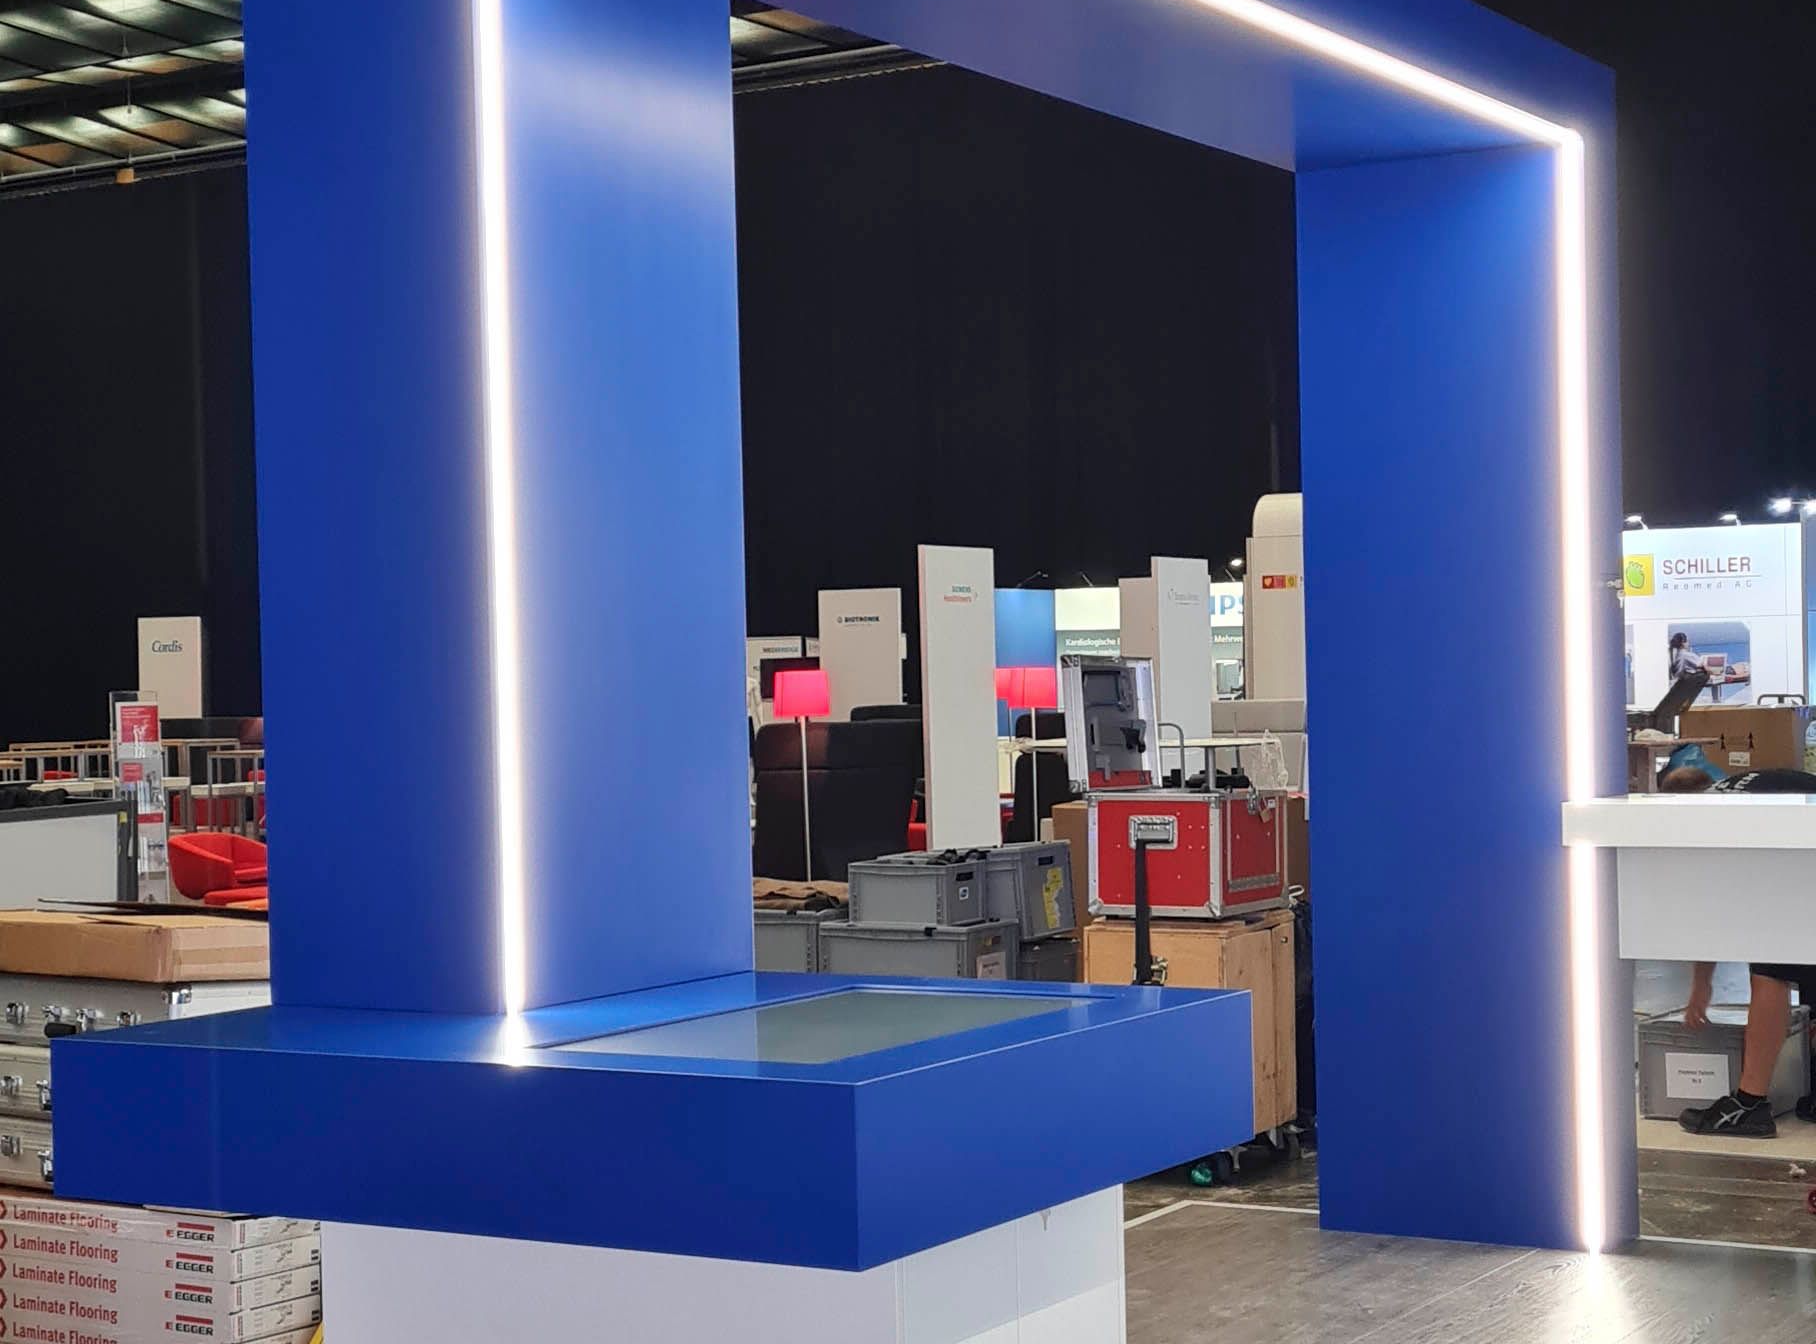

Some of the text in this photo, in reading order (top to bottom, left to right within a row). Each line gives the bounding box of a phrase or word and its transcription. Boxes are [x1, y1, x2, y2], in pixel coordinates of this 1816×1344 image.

[1663, 557, 1751, 575] SCHILLER
[151, 639, 183, 653] Cordis
[13, 1205, 118, 1234] Laminate Flooring
[176, 1230, 215, 1242] EGGER
[13, 1233, 118, 1264] Laminate Flooring
[175, 1261, 214, 1274] EGGER
[13, 1263, 117, 1294] Laminate Flooring
[174, 1291, 213, 1304] EGGER
[13, 1293, 118, 1324] Laminate Flooring
[13, 1322, 65, 1344] Laminate
[175, 1323, 213, 1336] EGGER
